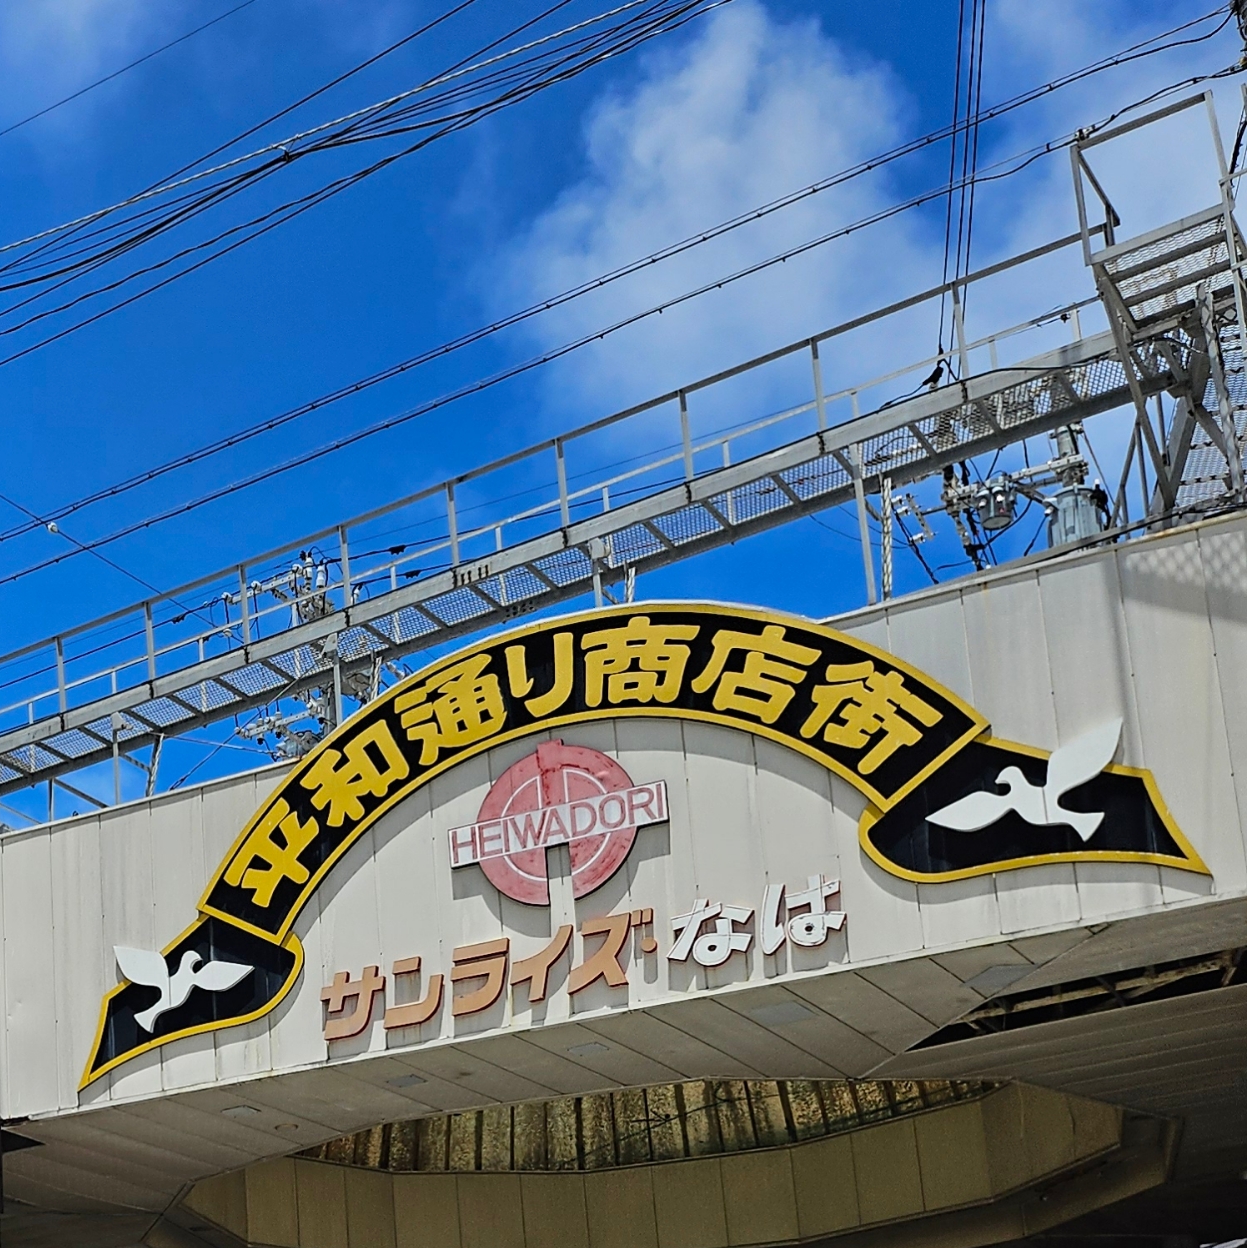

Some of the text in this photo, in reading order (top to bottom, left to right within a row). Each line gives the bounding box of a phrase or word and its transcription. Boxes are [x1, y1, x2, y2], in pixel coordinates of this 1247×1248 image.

[225, 615, 944, 909] 平和通り商店街
[450, 781, 666, 867] HEIWADORI
